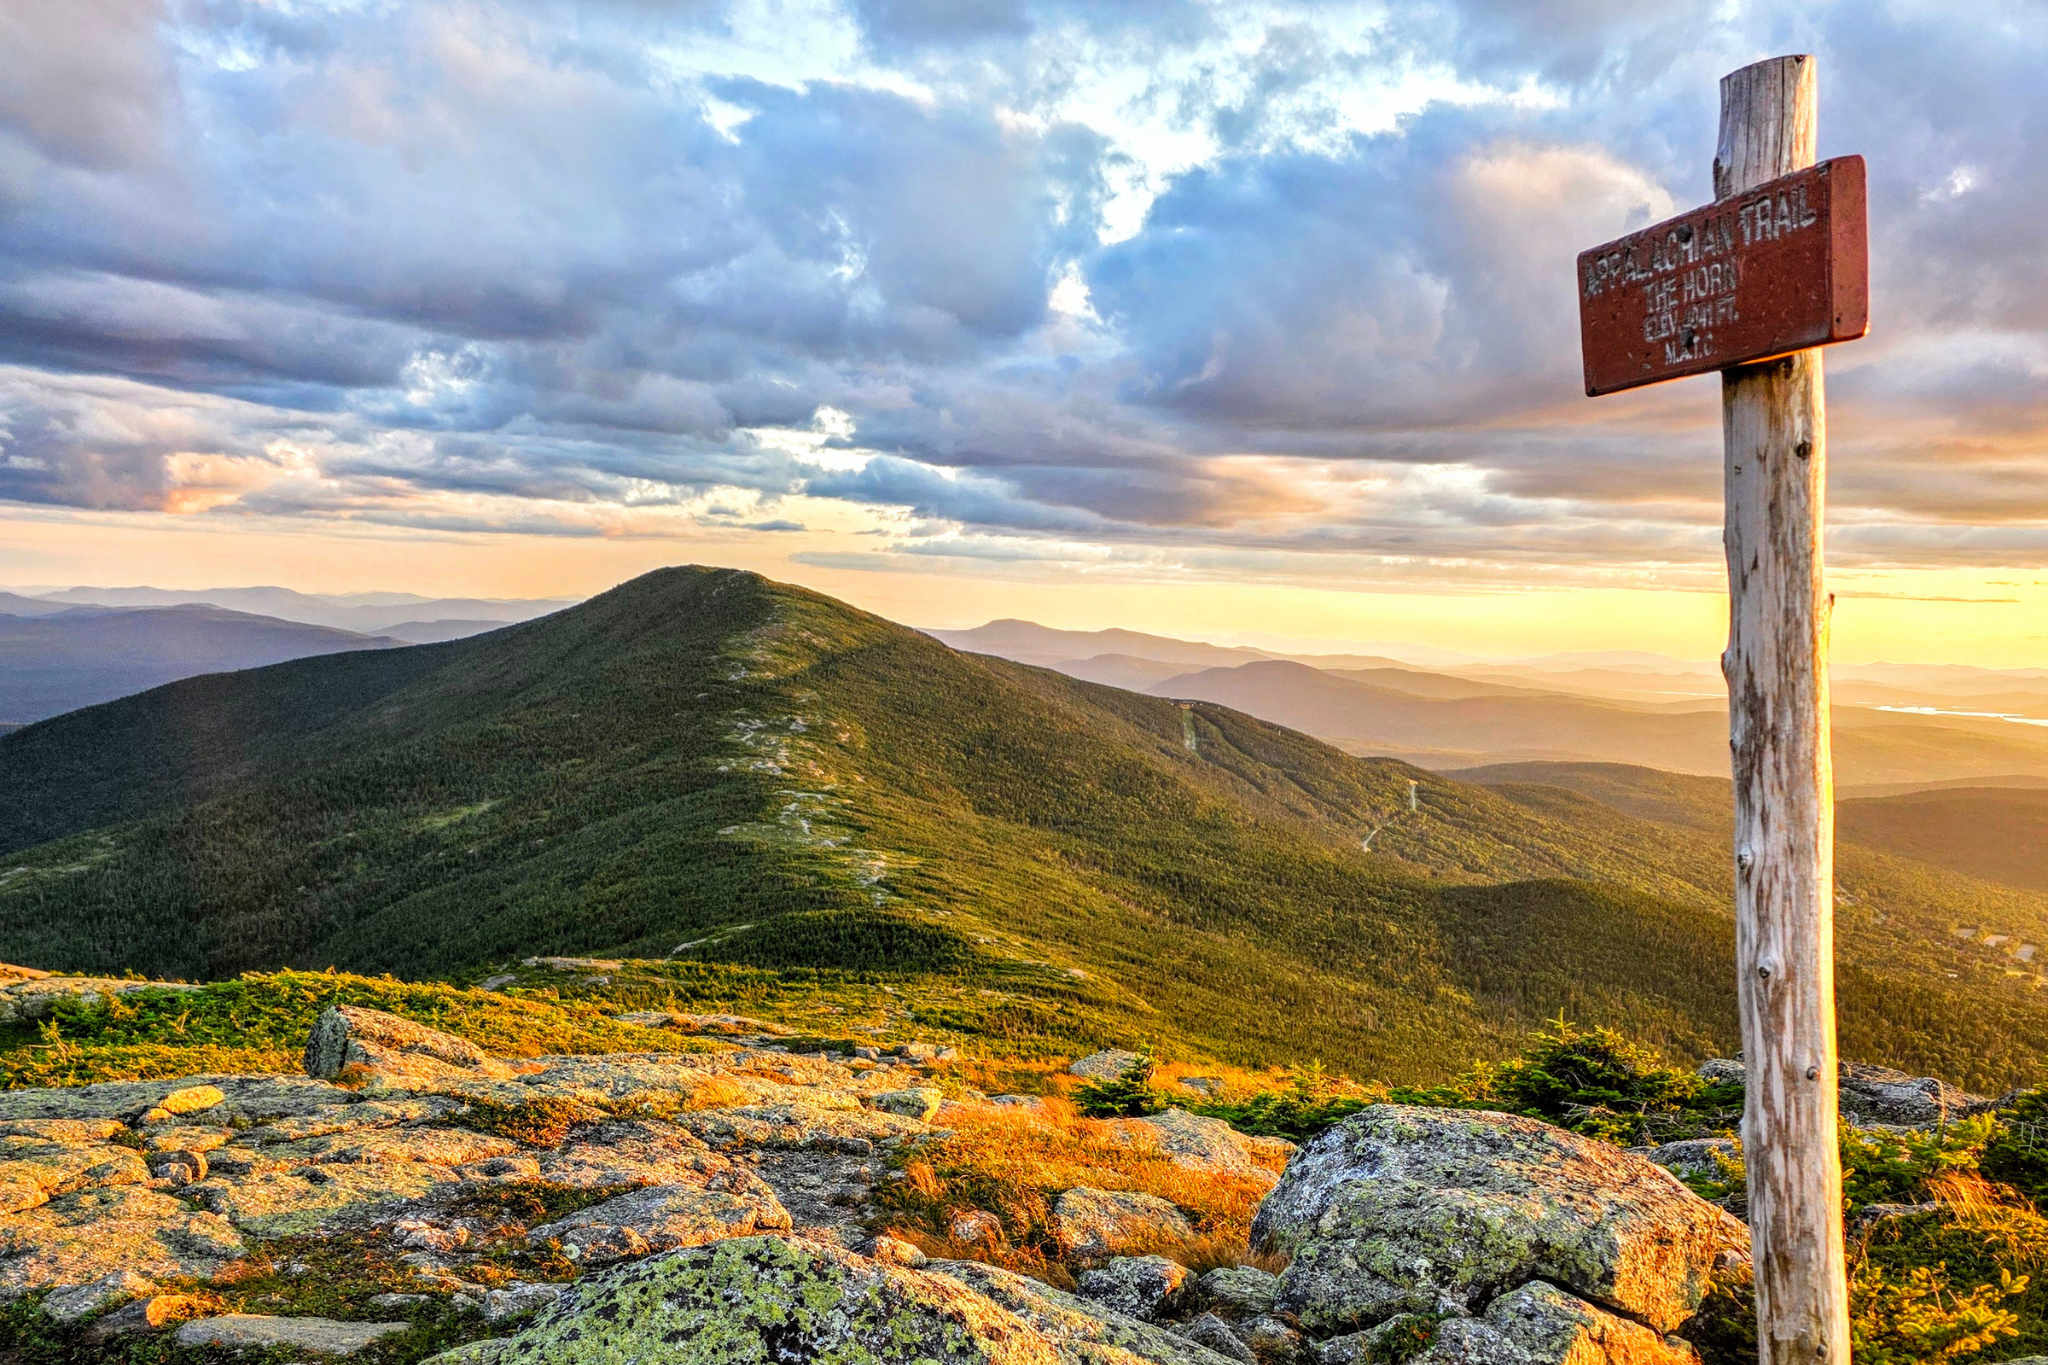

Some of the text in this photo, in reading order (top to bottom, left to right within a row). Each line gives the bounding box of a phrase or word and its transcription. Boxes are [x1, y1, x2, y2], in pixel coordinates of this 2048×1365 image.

[1739, 186, 1817, 246] TRAIL
[1643, 260, 1736, 312] THE HORN
